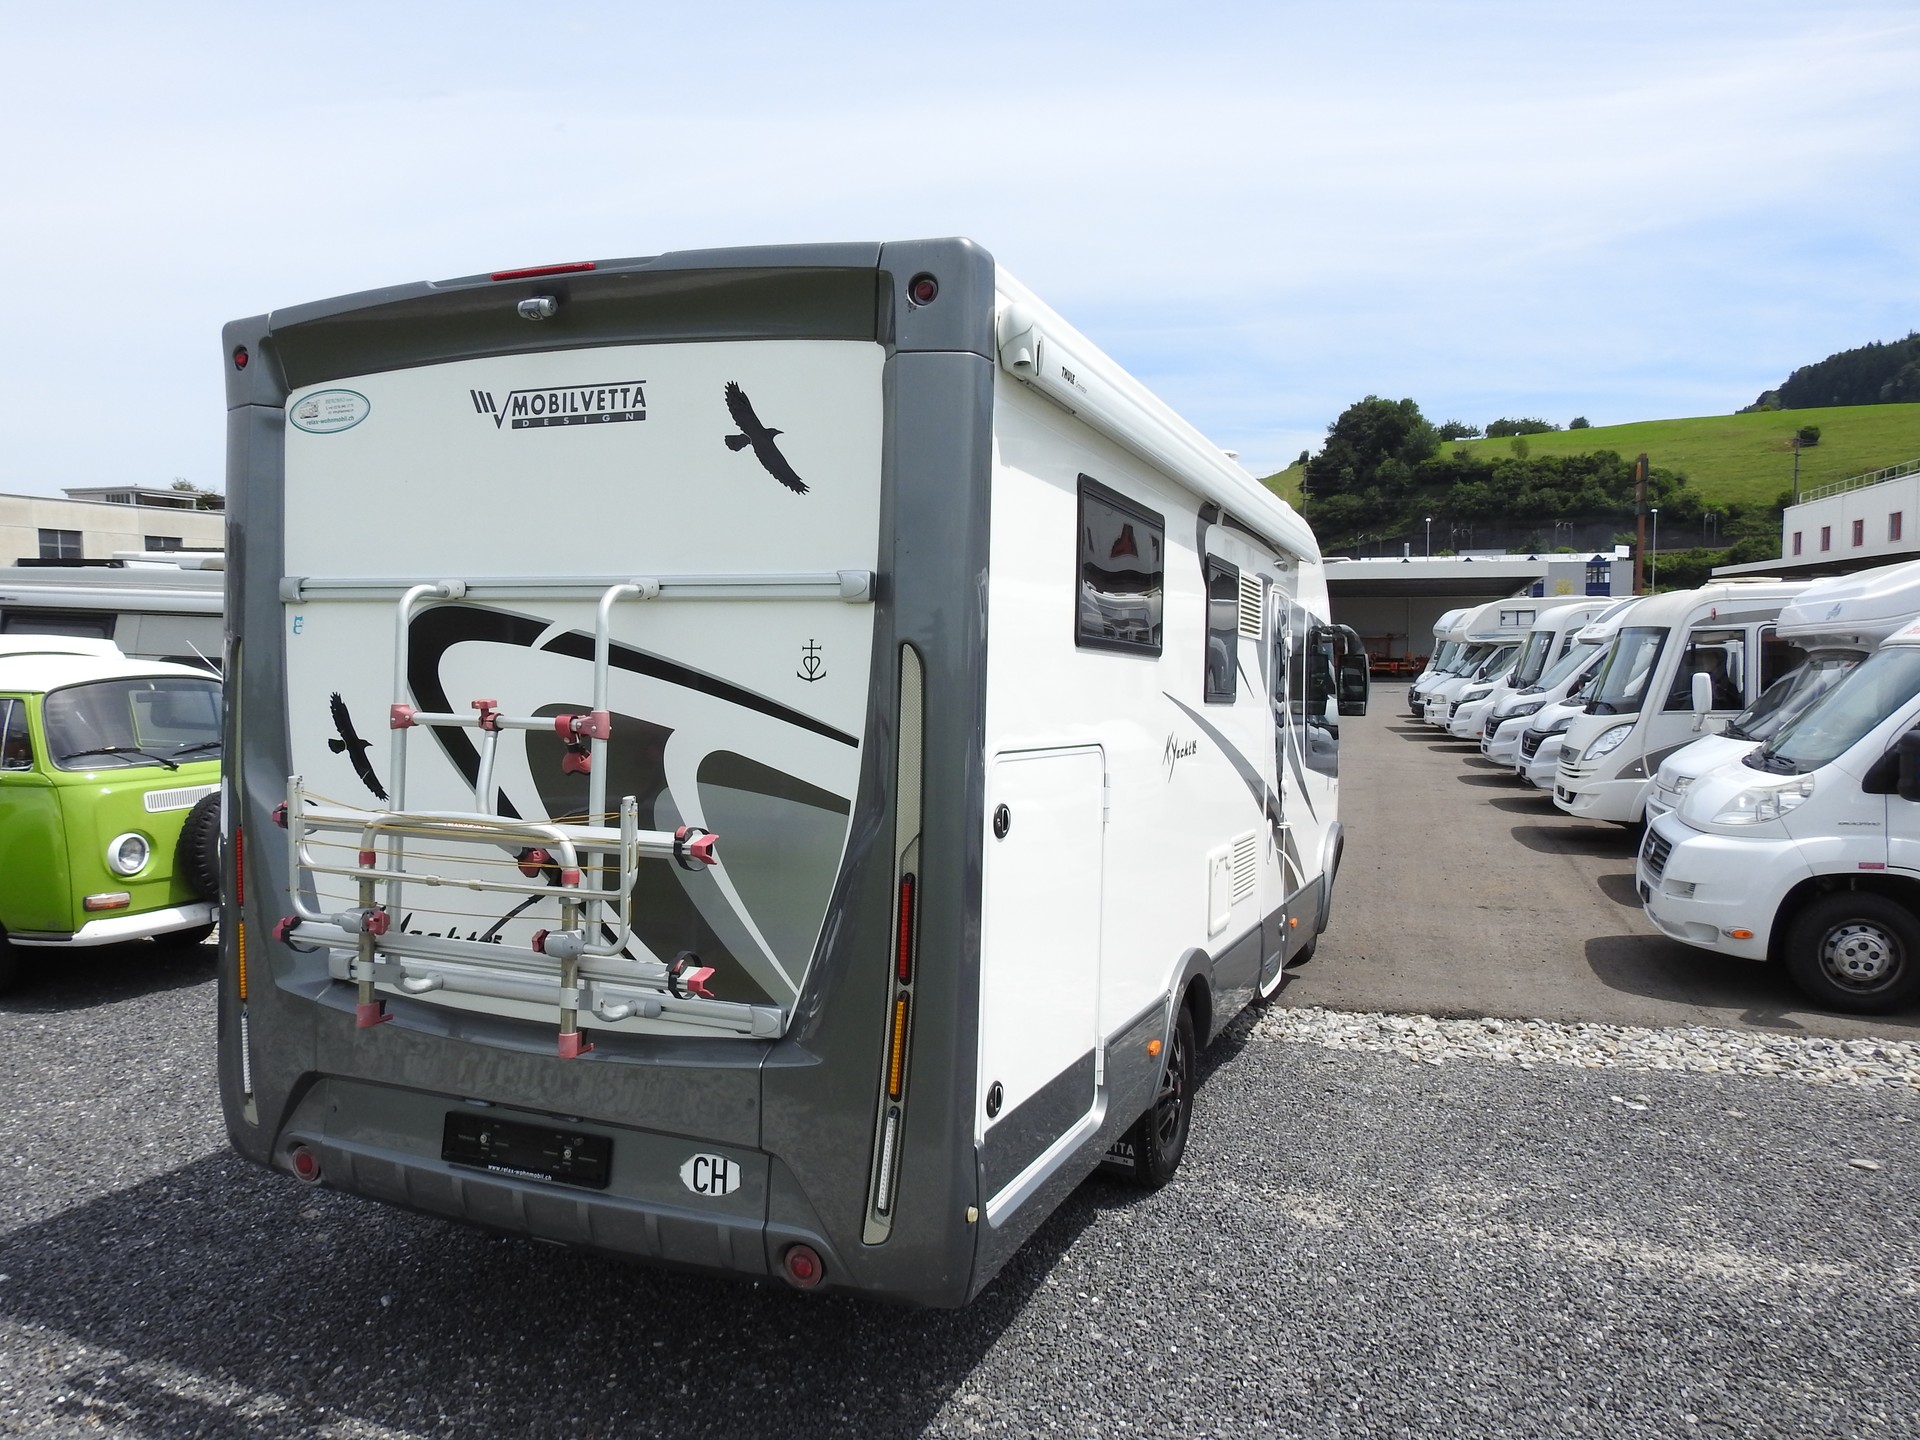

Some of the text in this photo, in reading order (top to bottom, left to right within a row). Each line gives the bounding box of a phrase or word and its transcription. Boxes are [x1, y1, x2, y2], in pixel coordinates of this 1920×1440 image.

[512, 386, 647, 417] MOBILVETTA
[522, 412, 635, 428] DESIGN
[1109, 1142, 1135, 1157] TTA
[693, 1156, 728, 1194] CH
